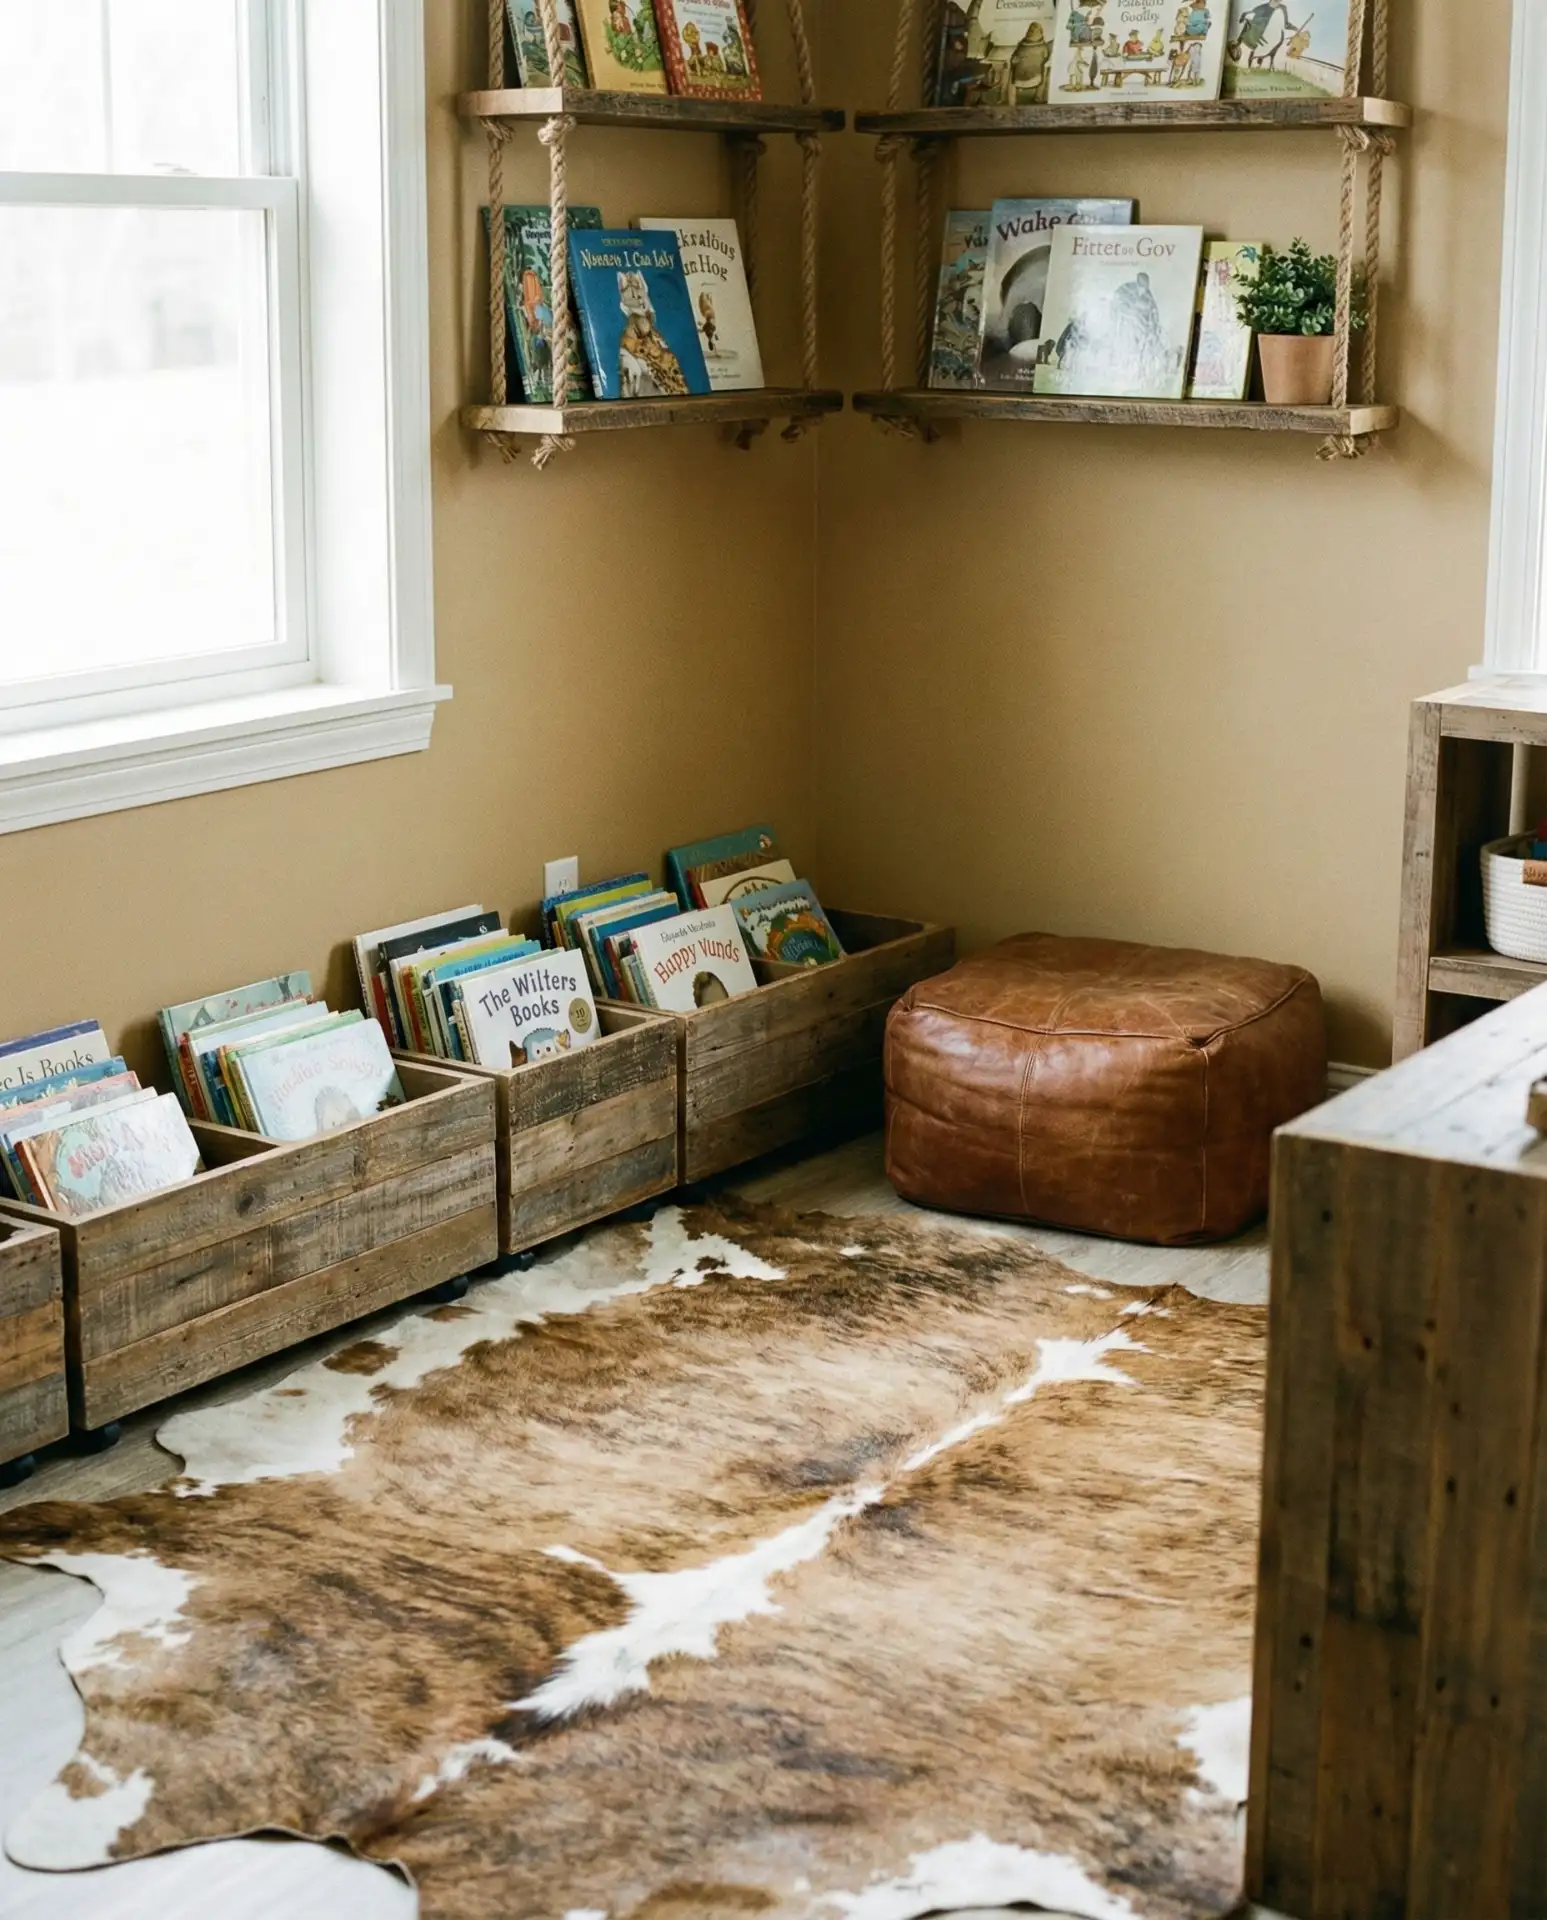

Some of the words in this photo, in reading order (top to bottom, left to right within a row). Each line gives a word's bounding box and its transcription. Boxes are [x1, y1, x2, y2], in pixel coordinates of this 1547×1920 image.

[996, 211, 1061, 241] Wake
[1136, 237, 1175, 257] Gov
[698, 254, 728, 281] Hog
[654, 944, 697, 984] Happy
[479, 988, 511, 1018] The
[512, 969, 577, 997] Wilters
[510, 994, 560, 1027] Books
[16, 1065, 36, 1085] Is
[40, 1050, 94, 1078] Books
